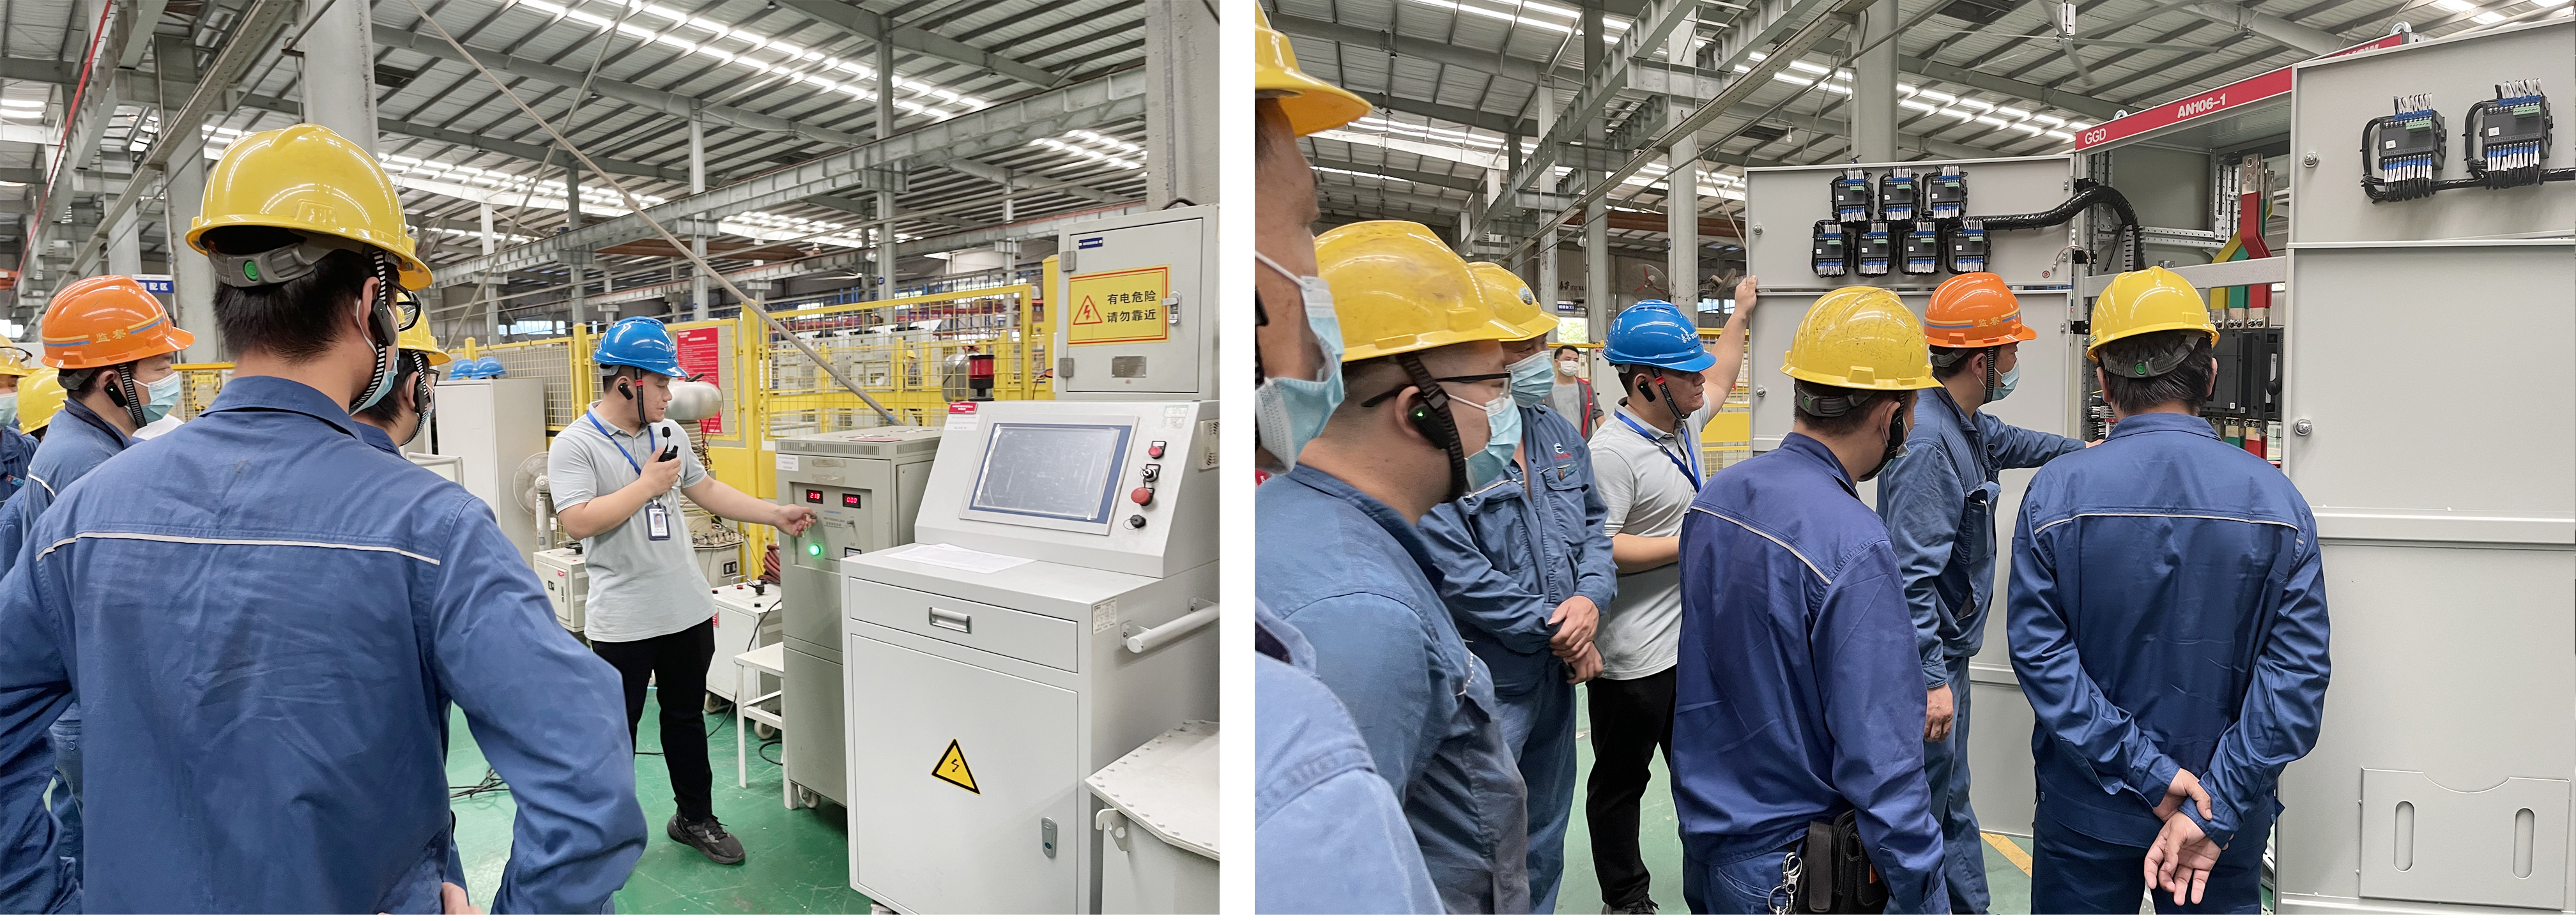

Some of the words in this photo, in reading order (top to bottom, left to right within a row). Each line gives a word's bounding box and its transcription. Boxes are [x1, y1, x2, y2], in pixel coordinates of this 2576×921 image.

[2177, 93, 2226, 119] AN106-1
[2085, 128, 2106, 145] GGD
[1107, 290, 1156, 305] 有电危险
[1107, 309, 1156, 323] 请勿靠近
[1977, 317, 2000, 328] 监察
[96, 329, 126, 343] 监察
